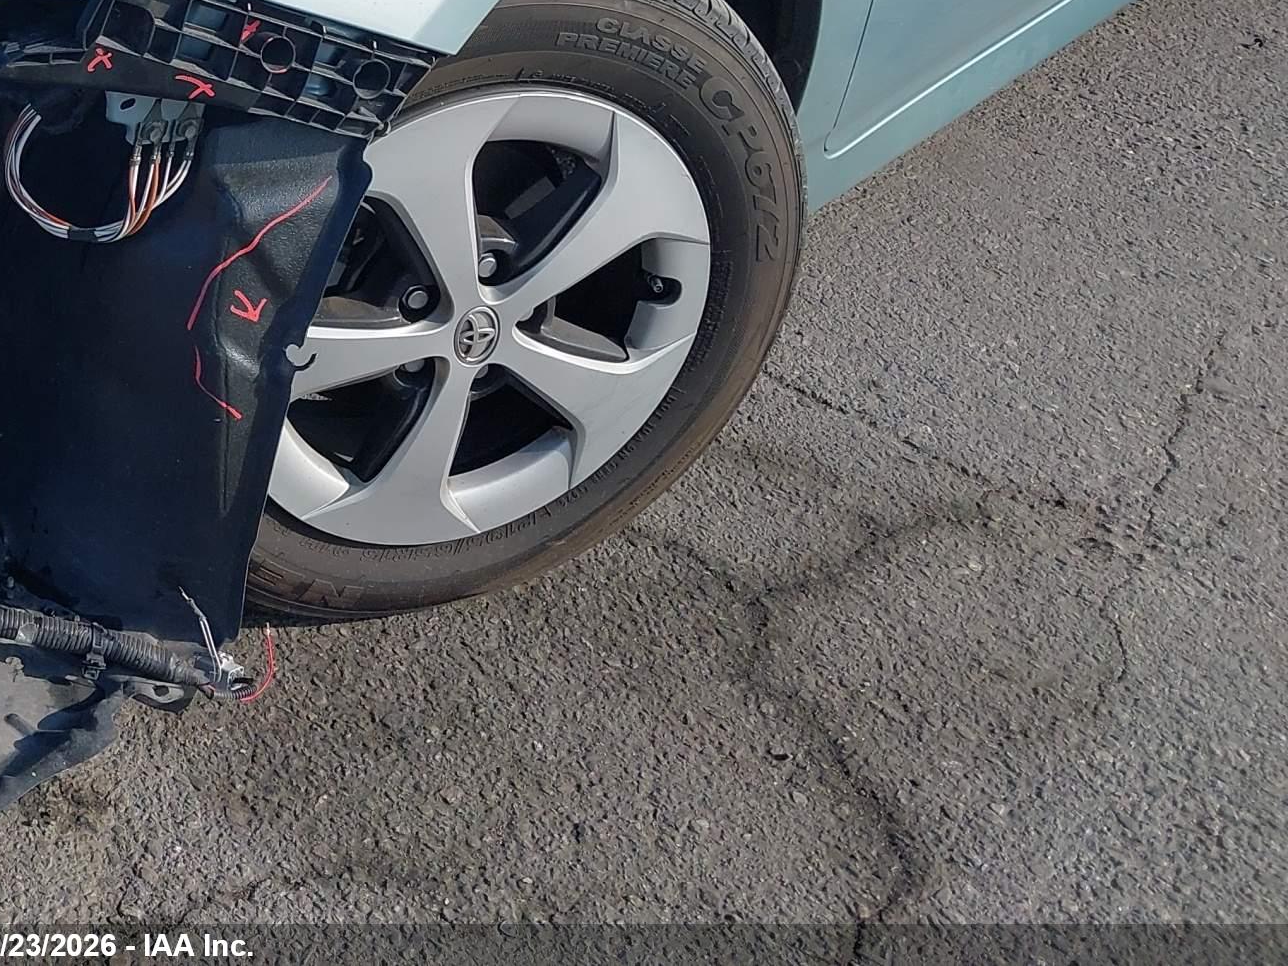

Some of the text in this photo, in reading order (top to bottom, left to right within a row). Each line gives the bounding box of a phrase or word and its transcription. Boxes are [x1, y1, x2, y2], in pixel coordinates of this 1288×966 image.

[556, 31, 698, 90] PREMIERE
[594, 16, 707, 74] CLASSE
[698, 75, 783, 264] CP672
